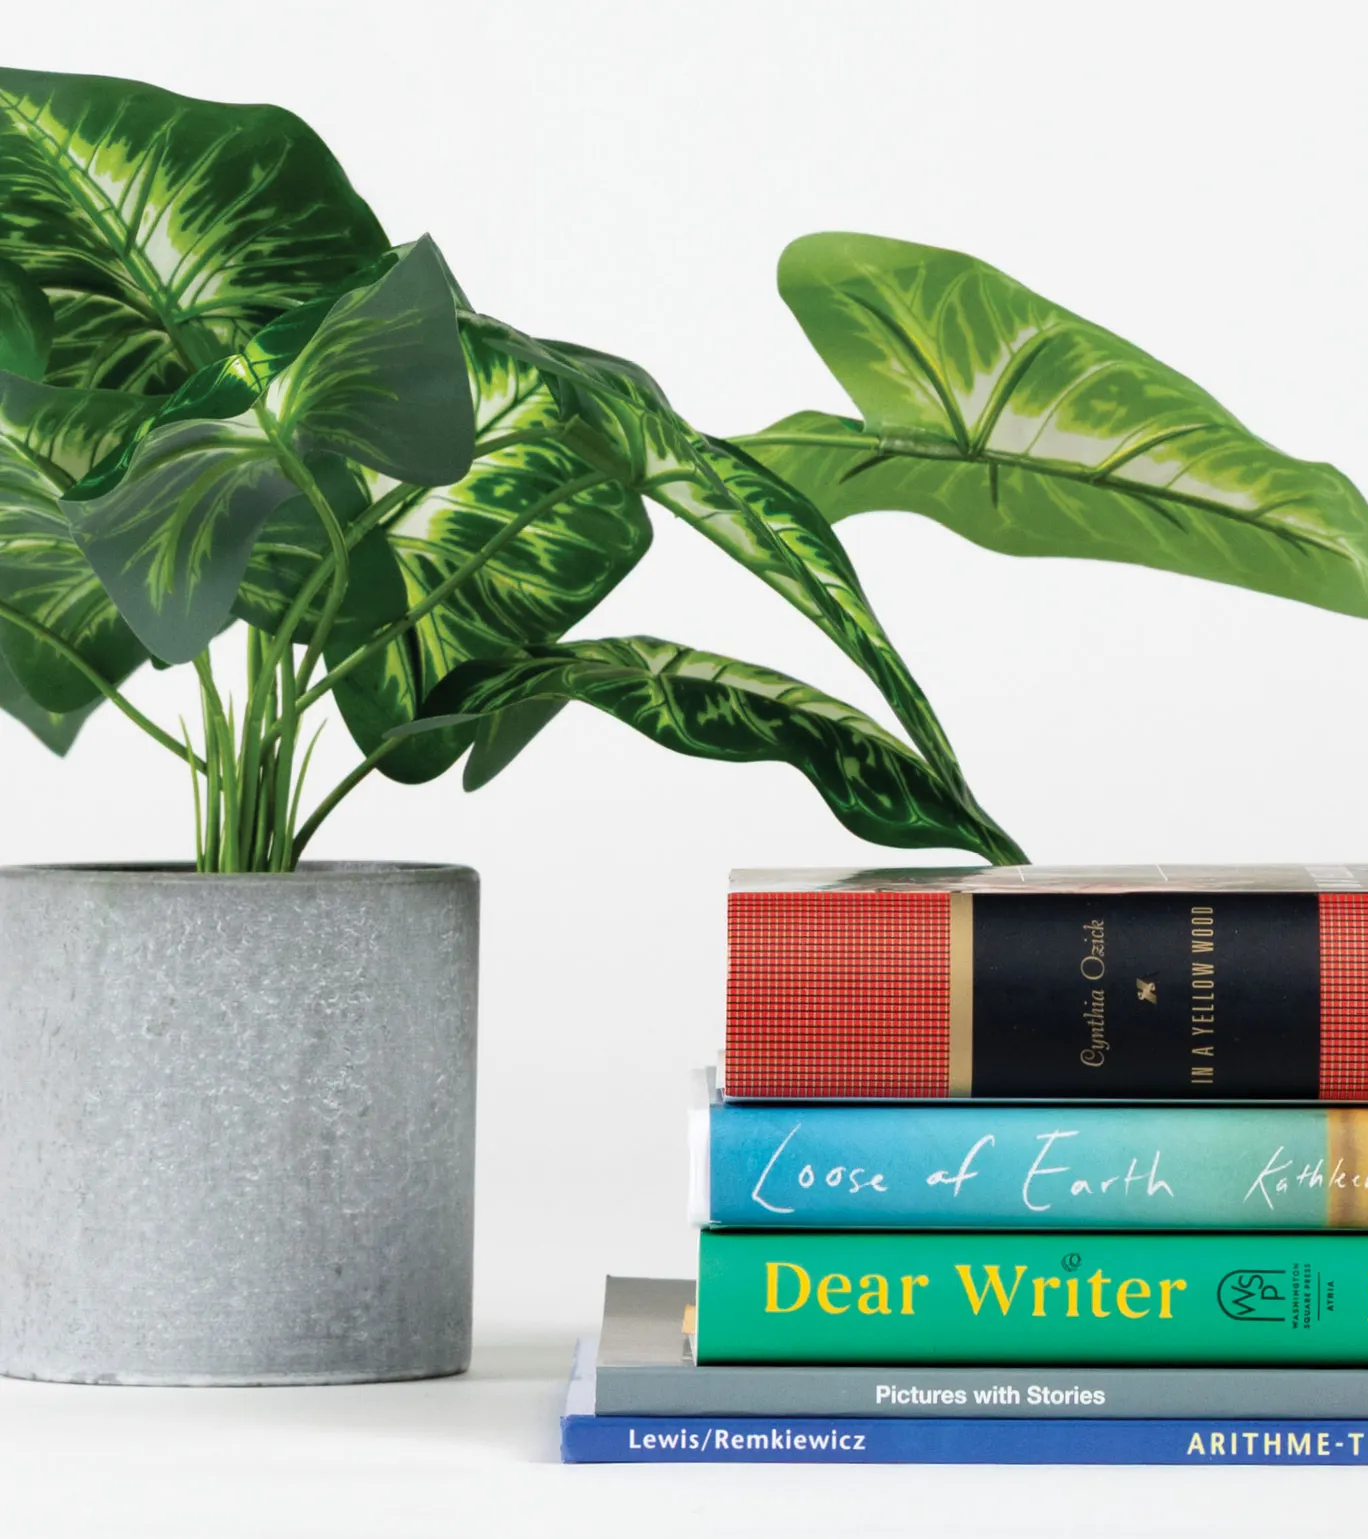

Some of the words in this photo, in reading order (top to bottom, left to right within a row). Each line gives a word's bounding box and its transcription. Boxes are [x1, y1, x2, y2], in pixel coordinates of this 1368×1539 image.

[1080, 919, 1105, 981] Ozick
[1191, 907, 1214, 953] WOOD
[1191, 962, 1215, 1036] YELLOW
[1080, 989, 1110, 1068] Cynthia
[1191, 1046, 1214, 1057] A
[1191, 1067, 1214, 1084] IN
[752, 1123, 890, 1213] Loose
[1022, 1130, 1175, 1211] Earth
[764, 1262, 929, 1315] Dear
[954, 1264, 1188, 1319] Writer
[1292, 1263, 1300, 1329] WASHINGTON
[1303, 1263, 1311, 1290] PRESS
[1326, 1281, 1335, 1311] ATRIA
[1303, 1293, 1311, 1329] SQUARE
[876, 1384, 967, 1405] Pictures
[973, 1385, 1021, 1405] with
[1027, 1385, 1106, 1405] Stories
[629, 1428, 866, 1452] Lewis/Remkiewicz
